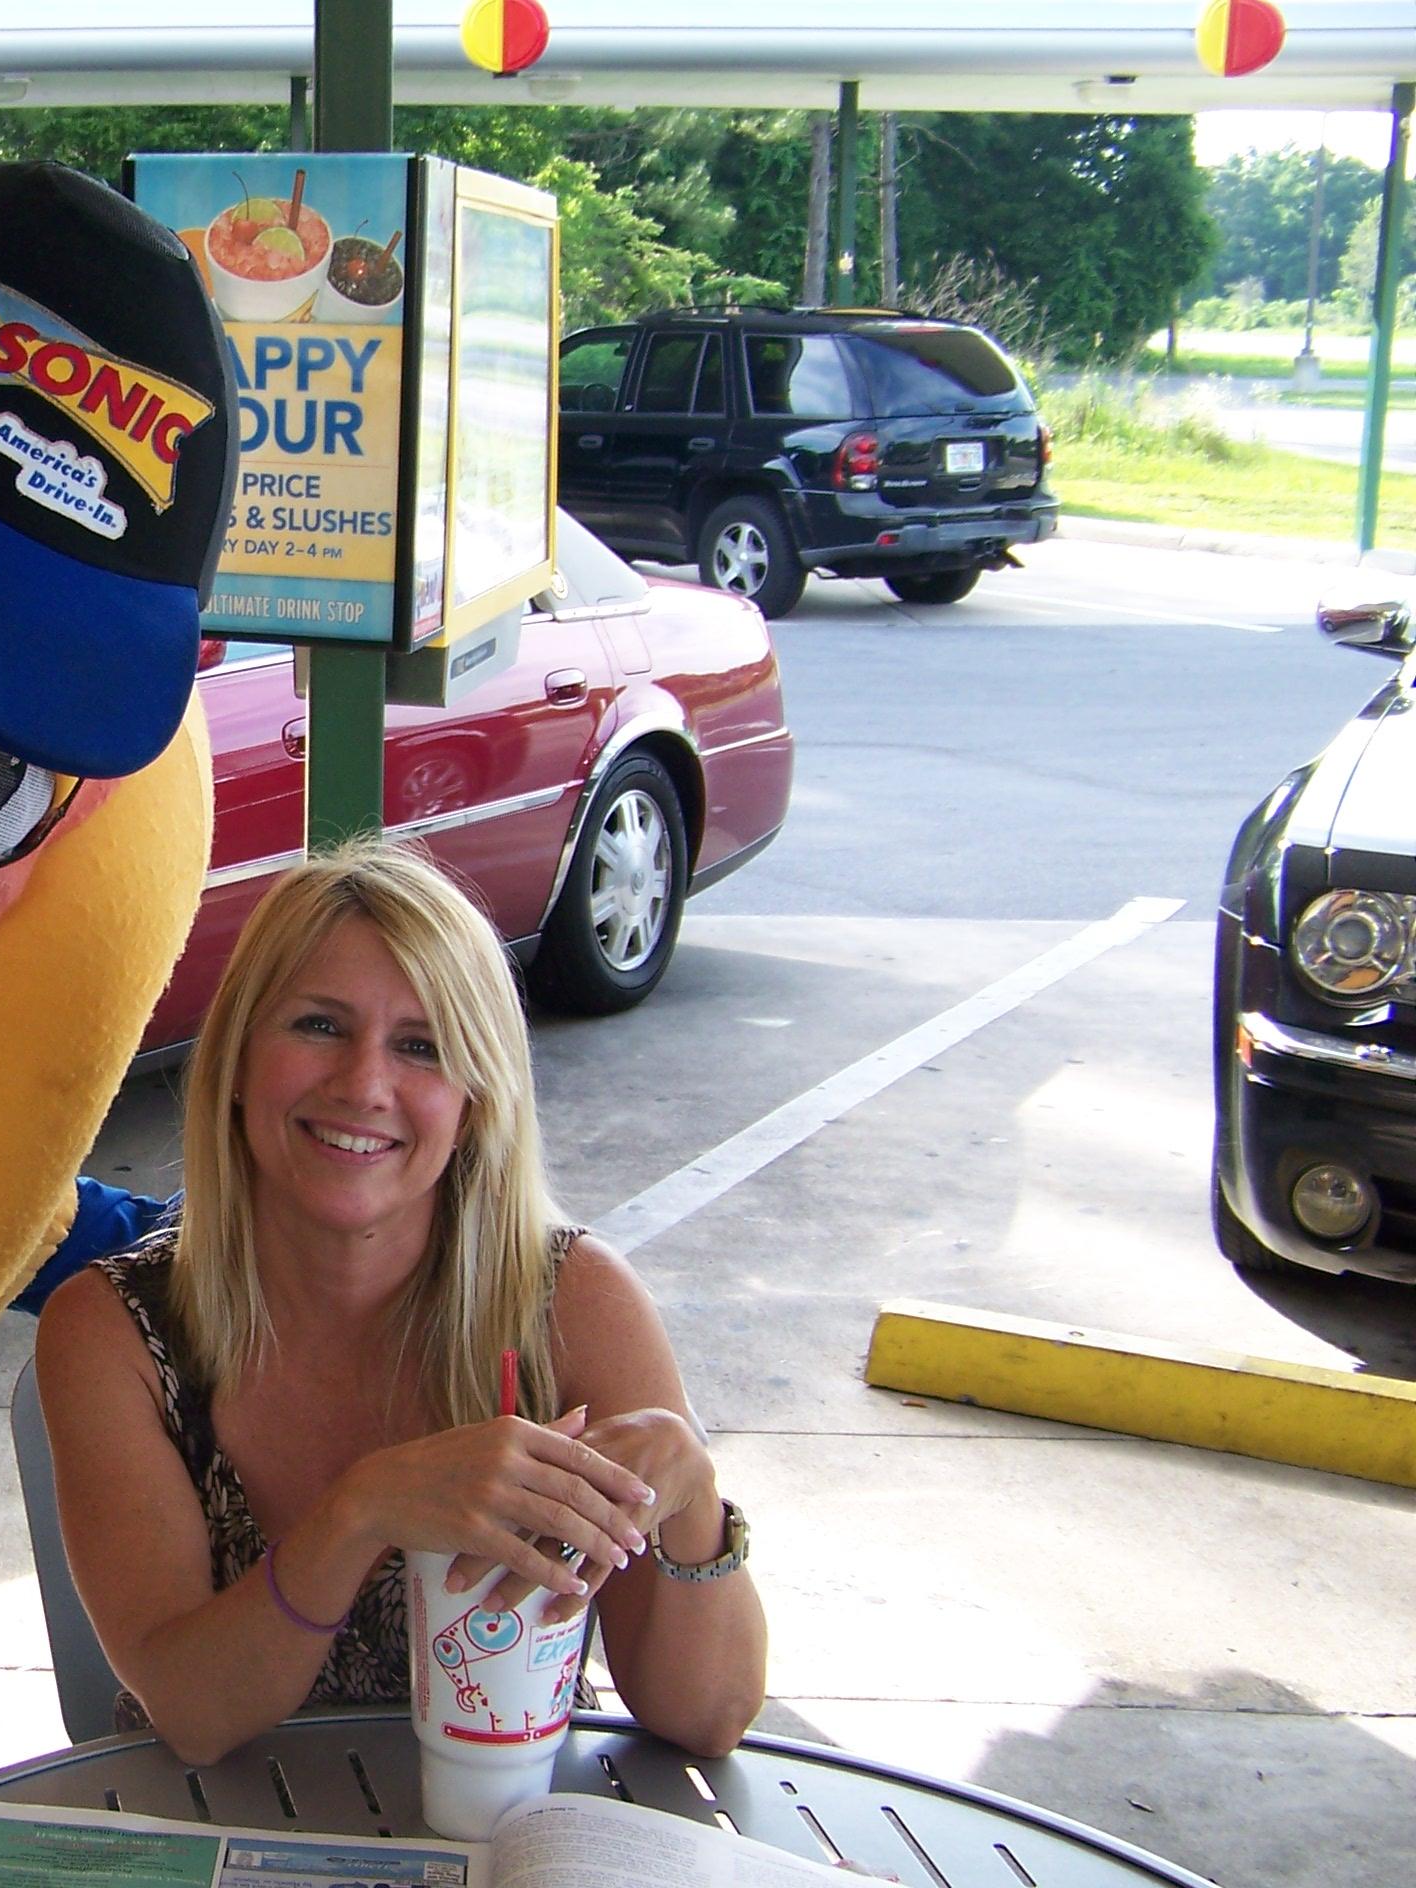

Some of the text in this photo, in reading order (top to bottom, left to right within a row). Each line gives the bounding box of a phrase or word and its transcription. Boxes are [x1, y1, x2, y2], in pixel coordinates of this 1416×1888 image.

[242, 472, 321, 499] PRICE
[246, 506, 265, 530] &
[272, 507, 393, 537] SLUSHES
[244, 539, 280, 555] DAY
[322, 547, 343, 559] PM
[276, 599, 321, 621] DRINK
[327, 602, 365, 623] STOP
